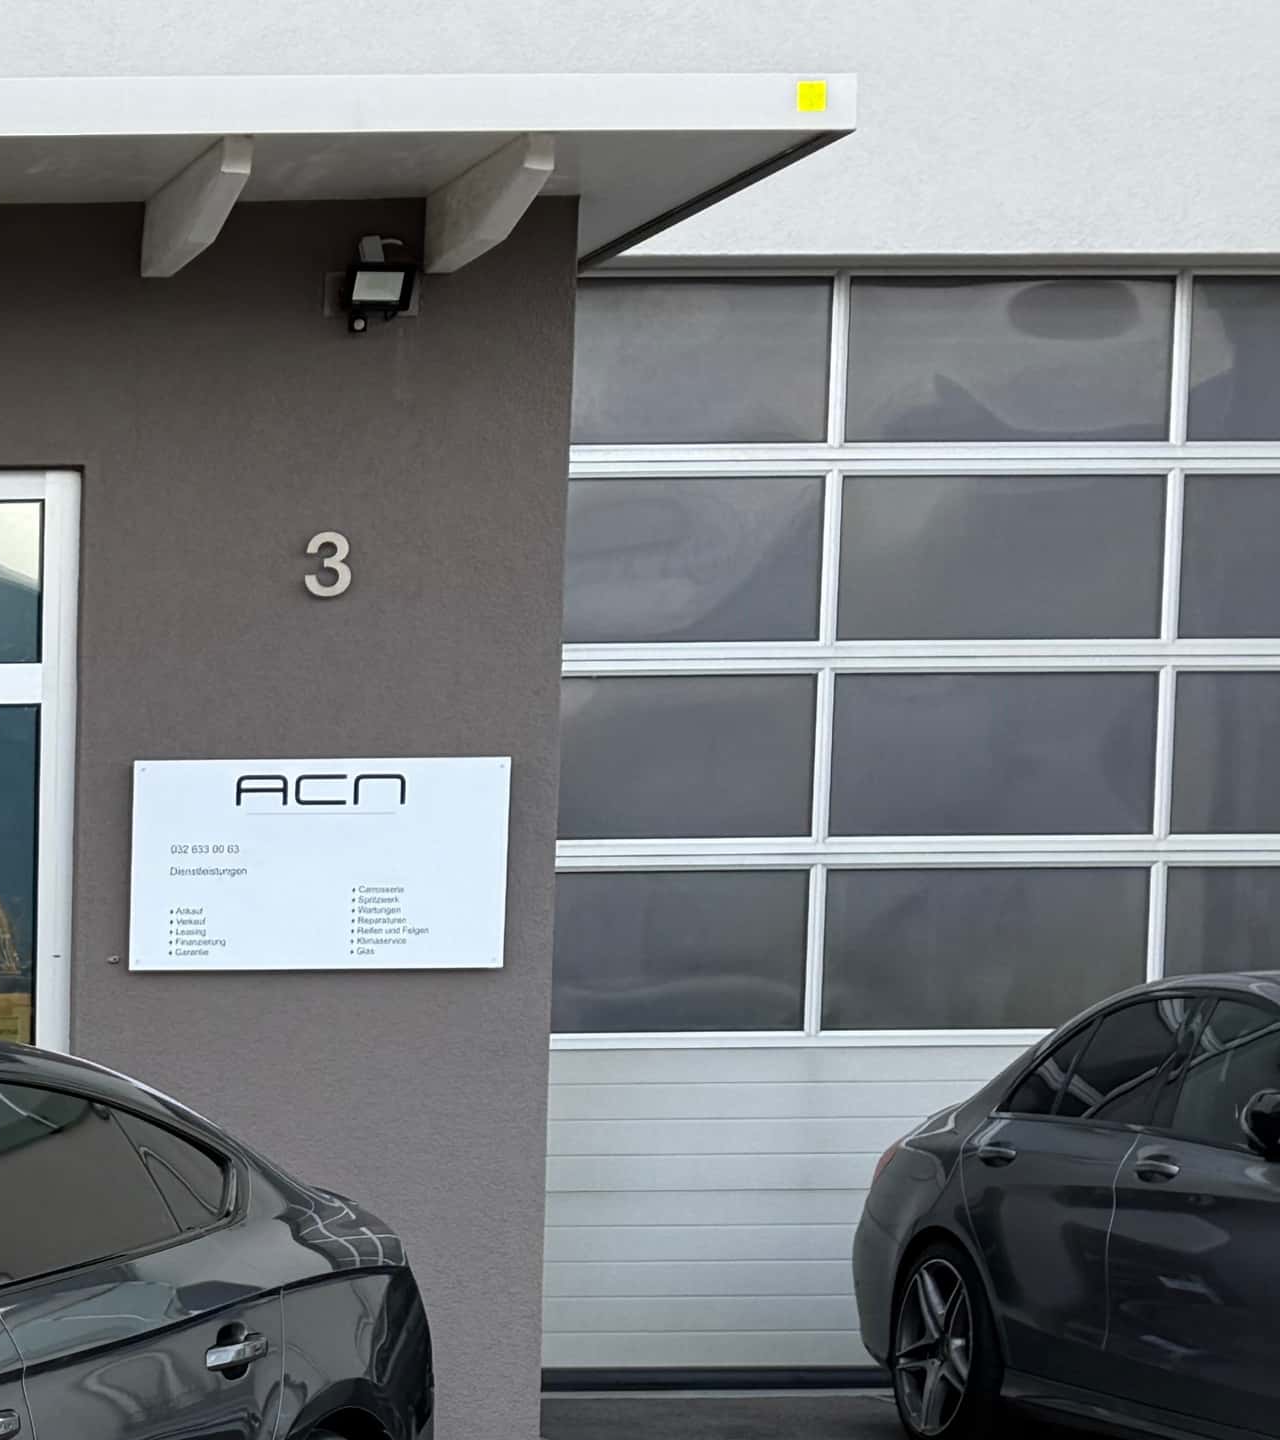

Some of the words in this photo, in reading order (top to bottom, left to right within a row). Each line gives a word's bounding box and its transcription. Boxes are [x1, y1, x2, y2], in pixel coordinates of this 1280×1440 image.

[304, 531, 352, 597] 3
[236, 774, 406, 806] ACN
[170, 844, 189, 854] 032
[212, 844, 225, 854] 00
[227, 844, 240, 854] 63
[170, 866, 248, 878] Dienstleistungen
[176, 917, 206, 925] Verkauf
[175, 928, 206, 937] Leasing
[385, 926, 400, 934] und
[175, 938, 226, 947] Finanzierung
